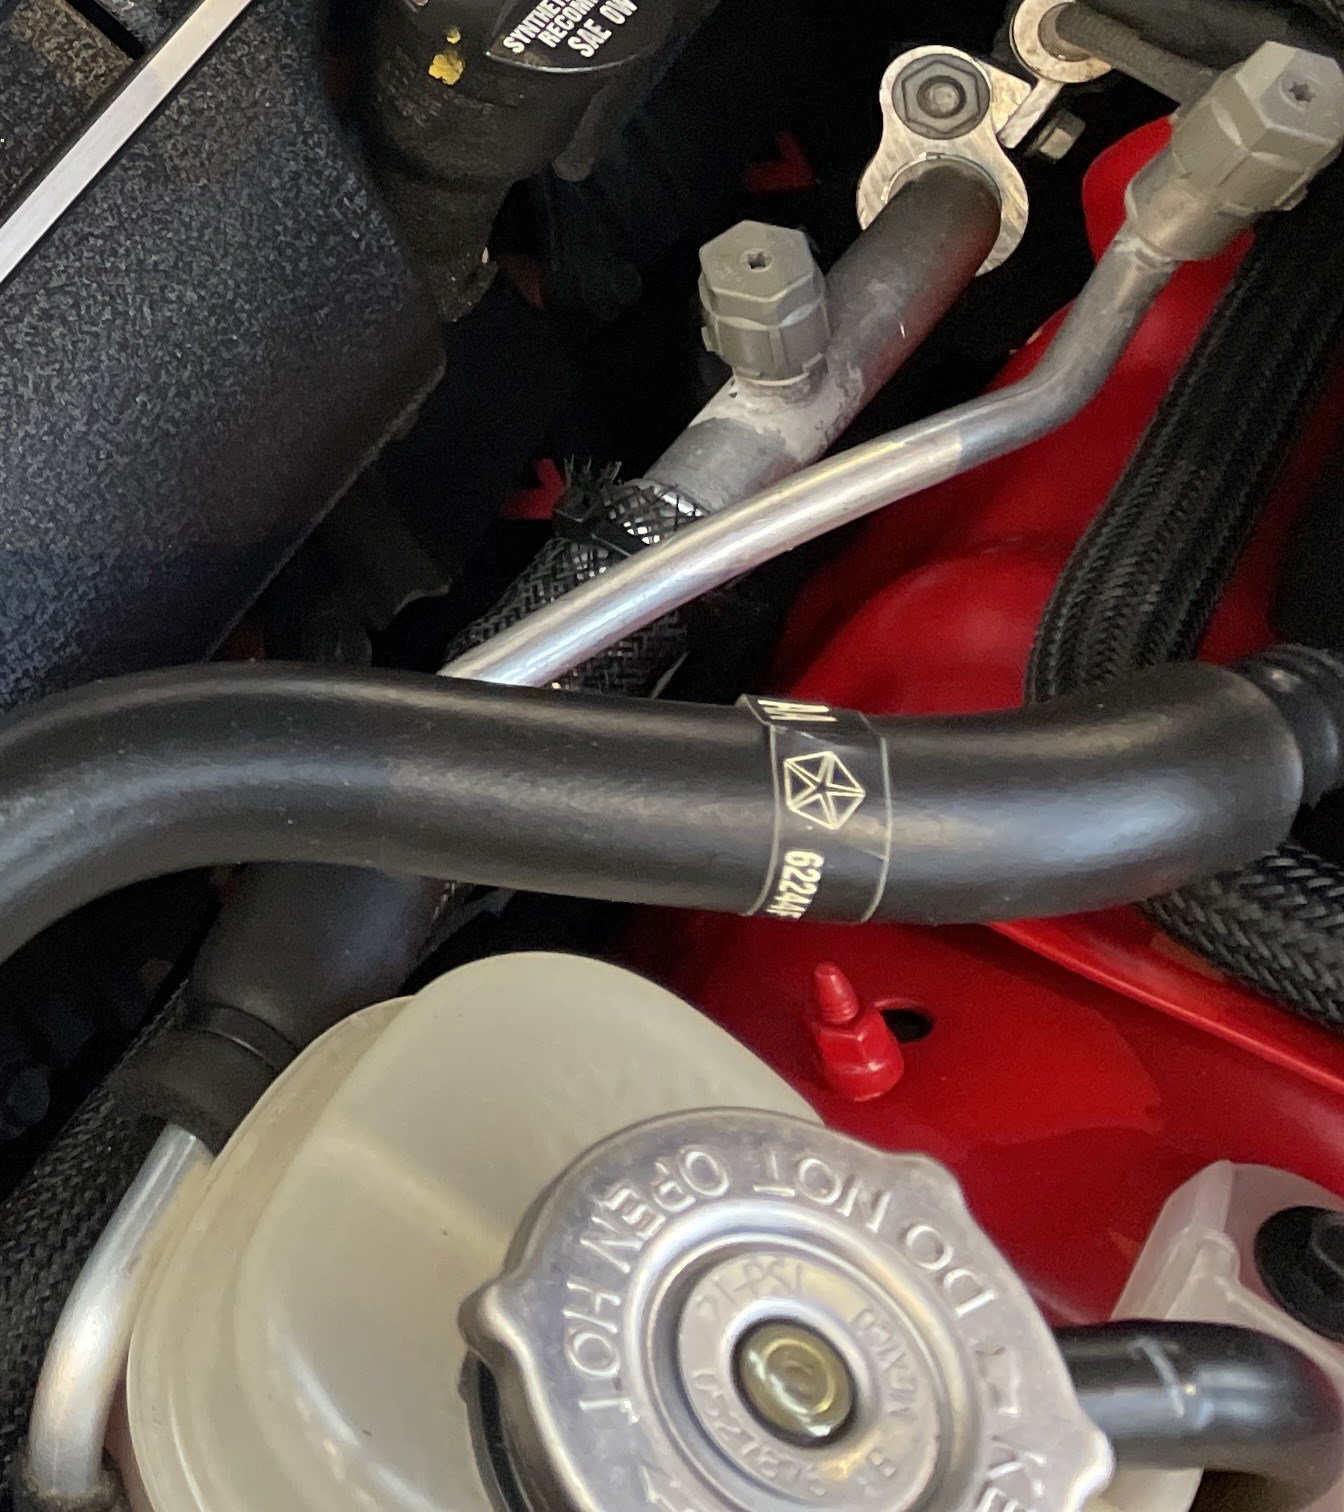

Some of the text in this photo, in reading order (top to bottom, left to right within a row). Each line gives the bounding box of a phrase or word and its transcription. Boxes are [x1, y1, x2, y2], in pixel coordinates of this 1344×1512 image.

[567, 18, 612, 58] SAE
[562, 1148, 998, 1425] DO NOT OPEN HOT
